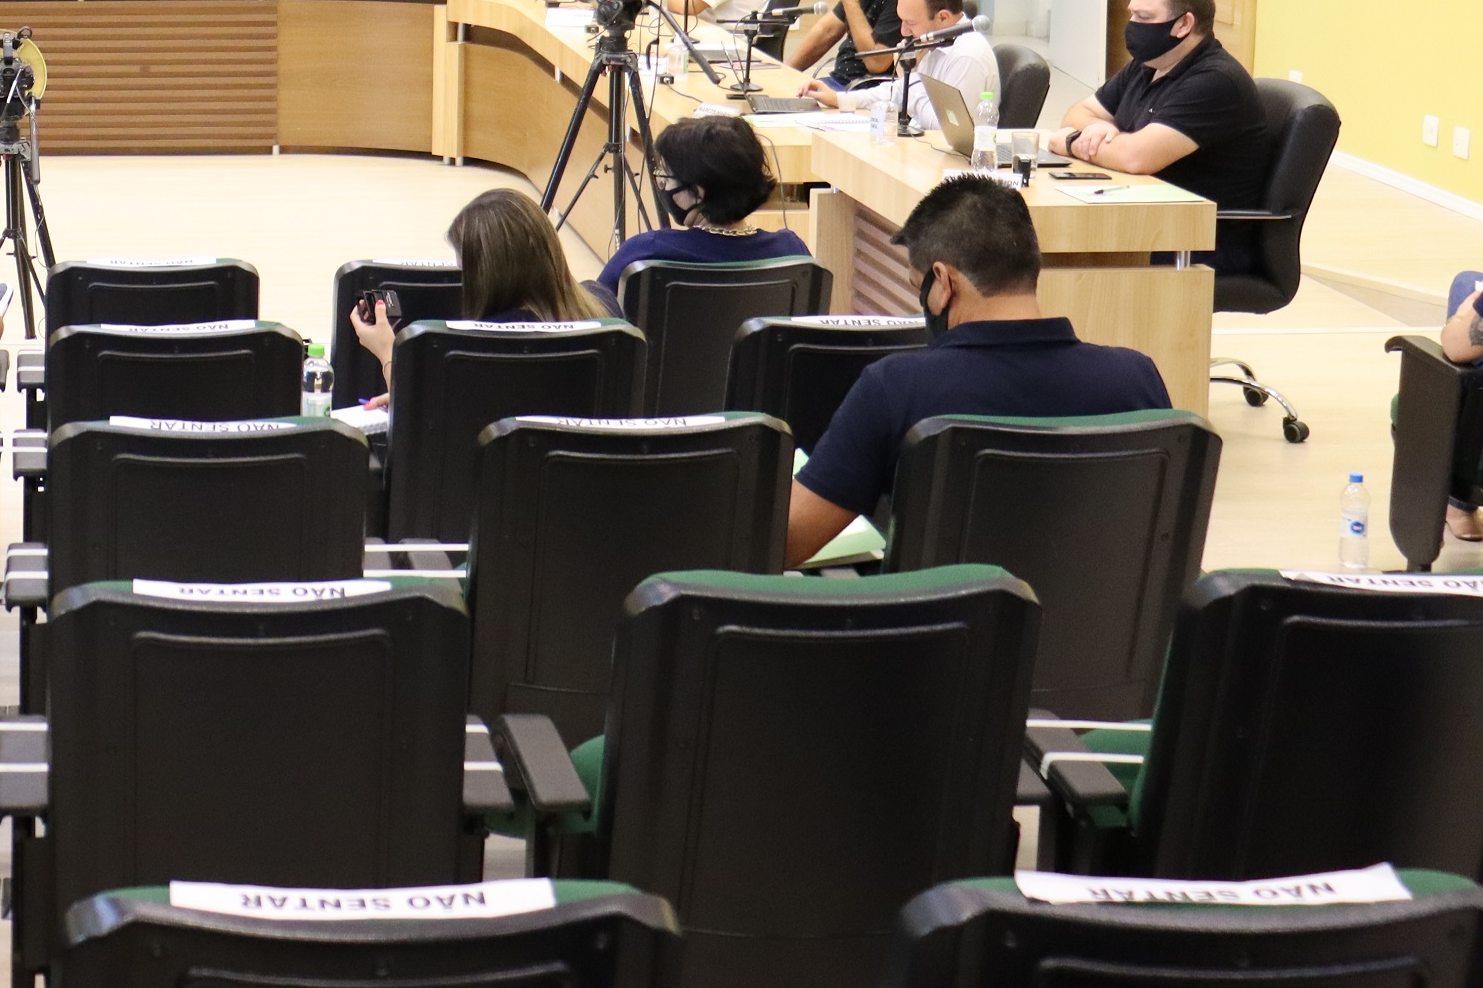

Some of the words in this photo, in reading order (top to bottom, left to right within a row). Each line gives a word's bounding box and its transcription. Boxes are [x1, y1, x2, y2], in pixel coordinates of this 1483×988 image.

[150, 420, 230, 432] SENTAR
[559, 418, 637, 428] SENTAR
[1326, 576, 1433, 587] SENTAR
[1443, 579, 1483, 593] ÃO
[178, 587, 282, 596] SENTAR
[292, 587, 346, 601] NÃO
[1086, 886, 1238, 902] SENTAR
[1254, 882, 1338, 900] NÃO
[240, 892, 390, 910] SENTAR
[408, 891, 486, 912] NÃO
